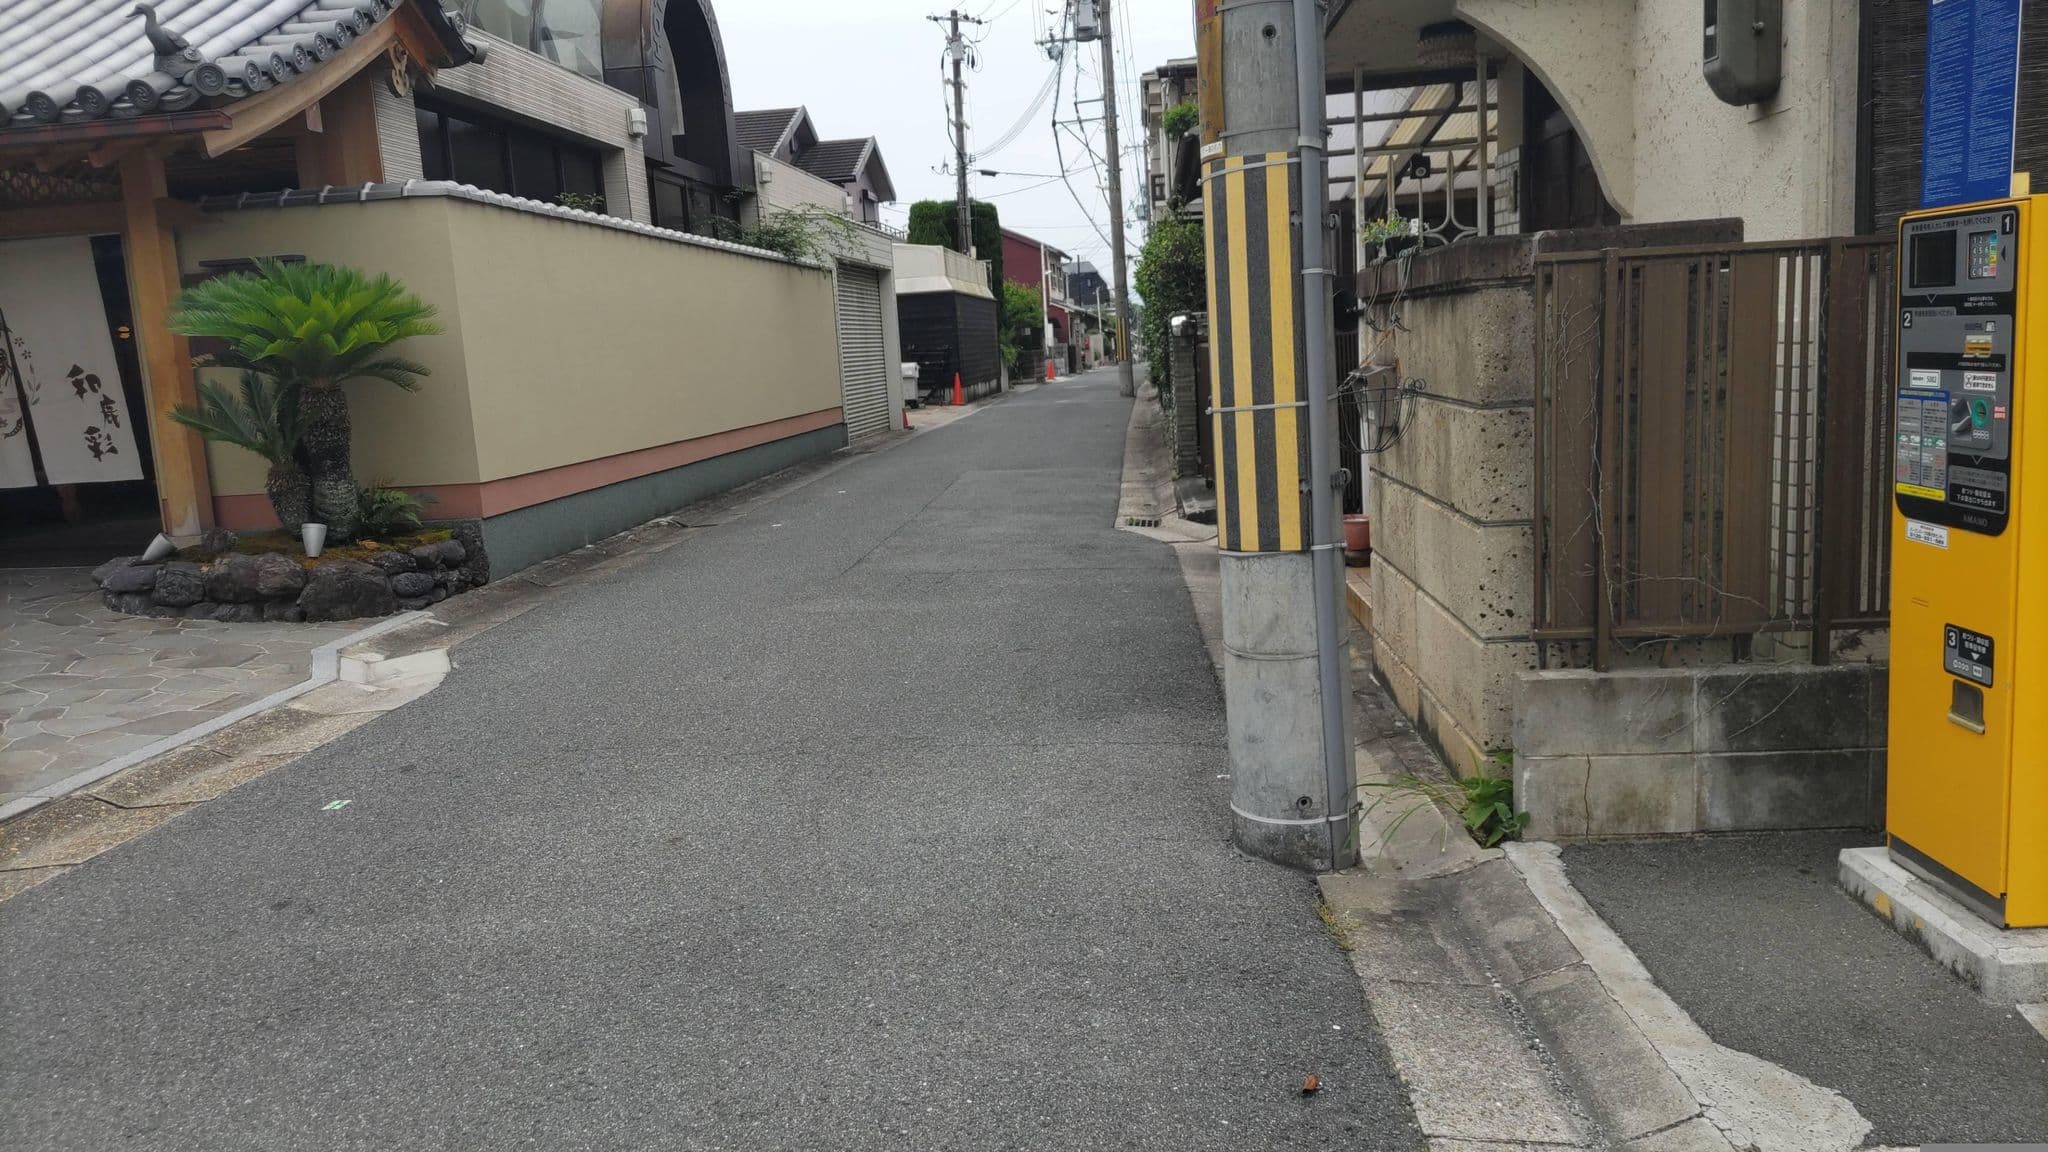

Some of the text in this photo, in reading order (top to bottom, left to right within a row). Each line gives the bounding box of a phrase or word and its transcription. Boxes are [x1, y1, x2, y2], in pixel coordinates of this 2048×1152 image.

[2004, 216, 2010, 232] 1
[1903, 312, 1911, 326] 2
[1948, 631, 1956, 646] 3
